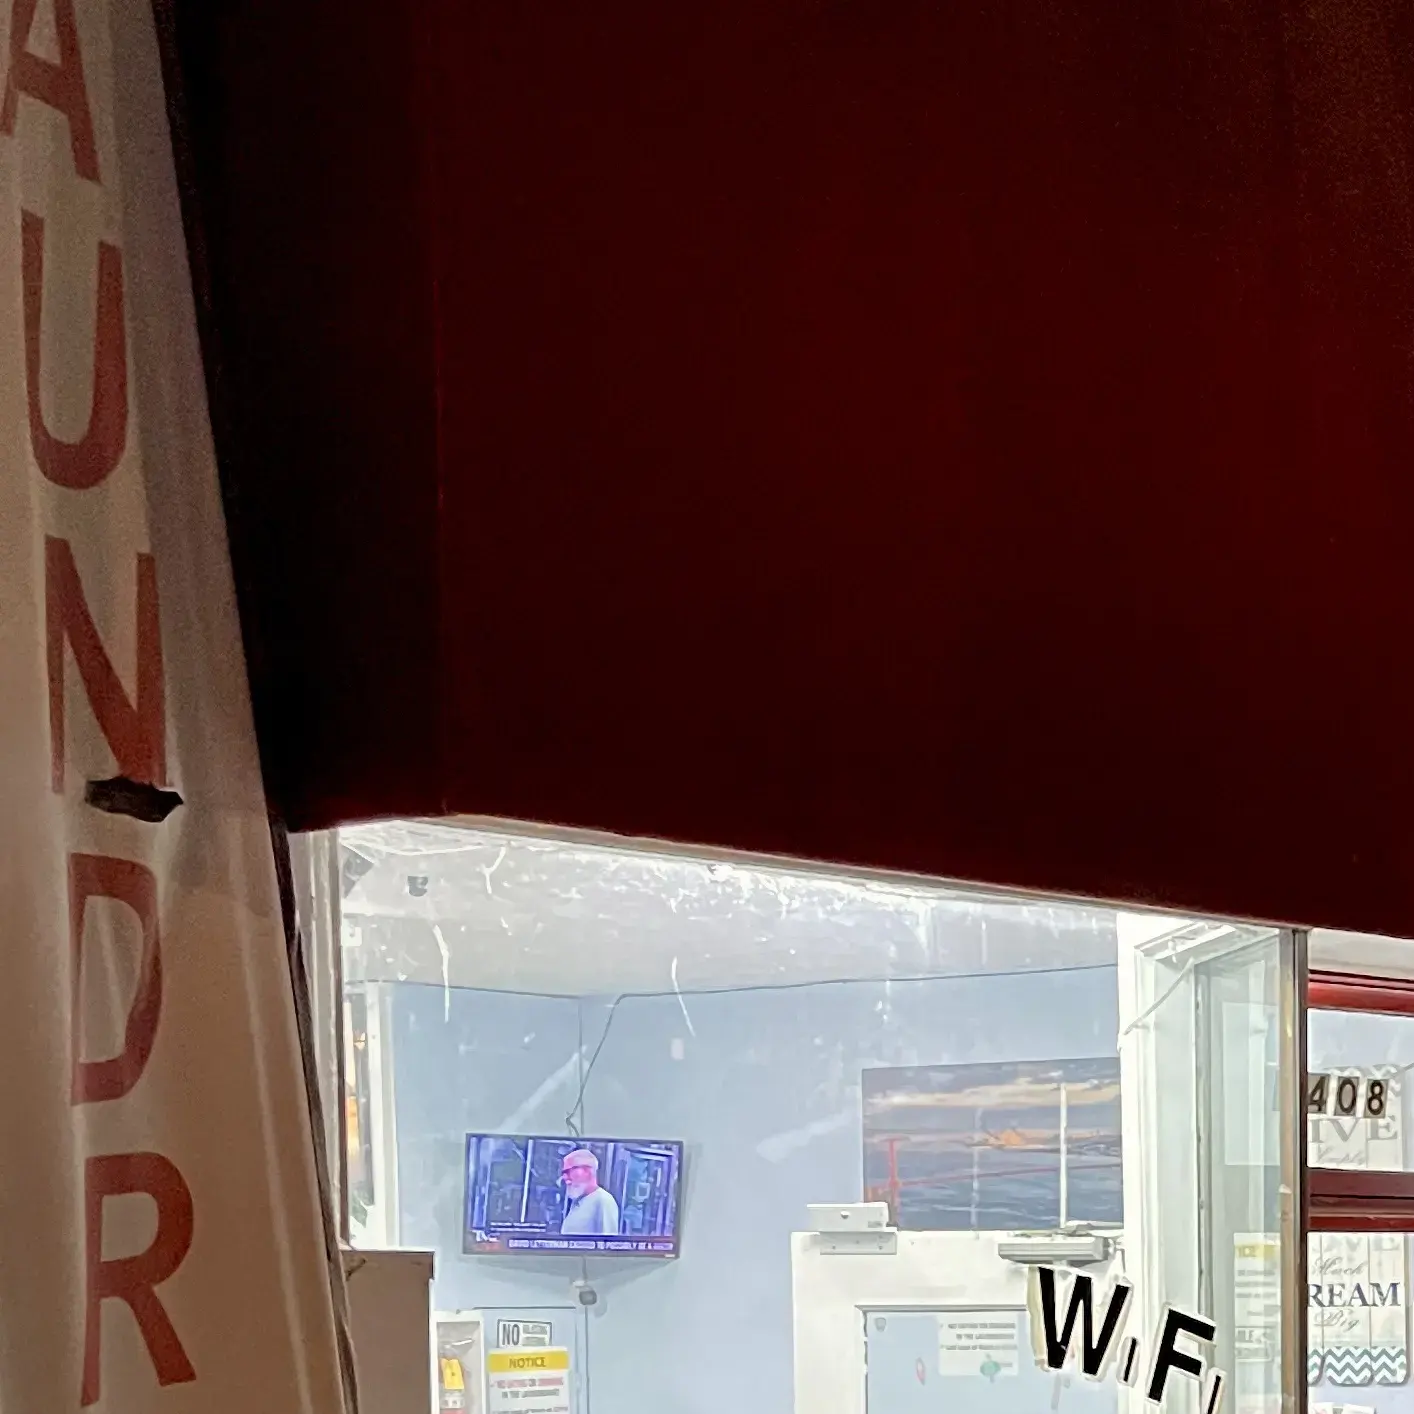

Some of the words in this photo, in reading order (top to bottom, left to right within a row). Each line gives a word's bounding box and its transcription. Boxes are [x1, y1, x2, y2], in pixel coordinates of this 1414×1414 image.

[1309, 1116, 1398, 1143] IVE
[1308, 1281, 1402, 1308] REAM
[502, 1323, 520, 1346] NO
[509, 1356, 547, 1369] NOTICE
